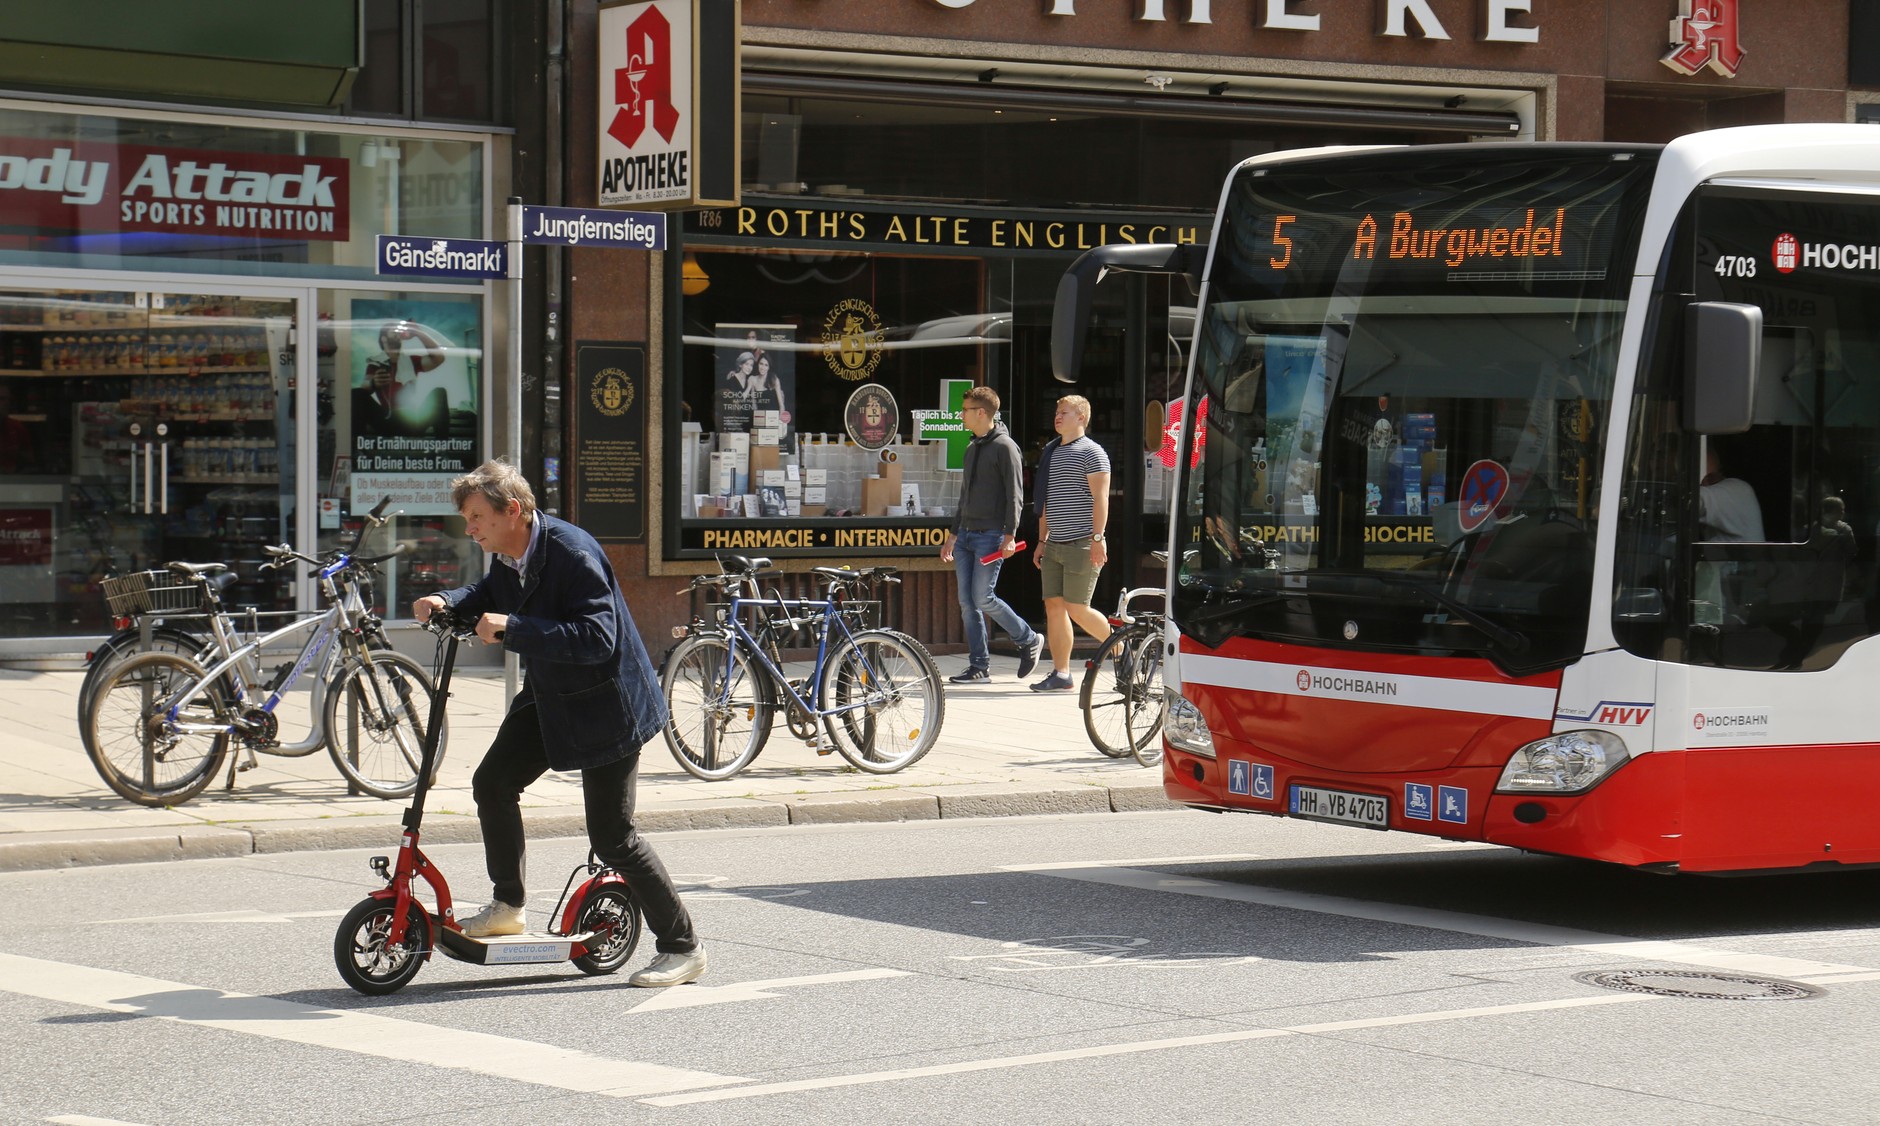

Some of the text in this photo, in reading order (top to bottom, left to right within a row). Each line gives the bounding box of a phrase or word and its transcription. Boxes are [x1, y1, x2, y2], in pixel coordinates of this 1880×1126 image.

[122, 154, 338, 207] Attack
[601, 150, 687, 194] APOTHEKE
[121, 200, 335, 233] SPORTS NUTRITION
[699, 210, 722, 228] 1786
[738, 207, 866, 240] ROTH'S
[884, 215, 970, 245] ALTE
[533, 212, 656, 248] Jungfernstieg
[1269, 208, 1565, 269] 5 A Burgwedel
[386, 240, 501, 272] Gänsemarkt
[1714, 255, 1756, 278] 4703
[723, 403, 754, 411] TRINKEN
[941, 410, 953, 420] bis
[919, 421, 963, 432] Sonnabend
[357, 435, 473, 454] Der Ernährungspartner
[357, 455, 464, 470] für Deine beste Form.
[357, 477, 368, 490] Ob
[370, 477, 425, 490] Muskelaufbau
[426, 477, 444, 490] oder
[357, 490, 376, 504] alles
[414, 490, 433, 504] Ziele
[703, 529, 814, 548] PHARMACIE
[1312, 675, 1398, 696] HOCHBAHN
[1598, 707, 1651, 725] HVV
[1706, 714, 1768, 727] HOCHBAHN
[1300, 790, 1318, 813] HH
[1328, 793, 1346, 817] YB
[1349, 797, 1385, 822] 4703
[494, 954, 532, 962] INTELLIGENTE
[502, 943, 556, 954] evectro.com
